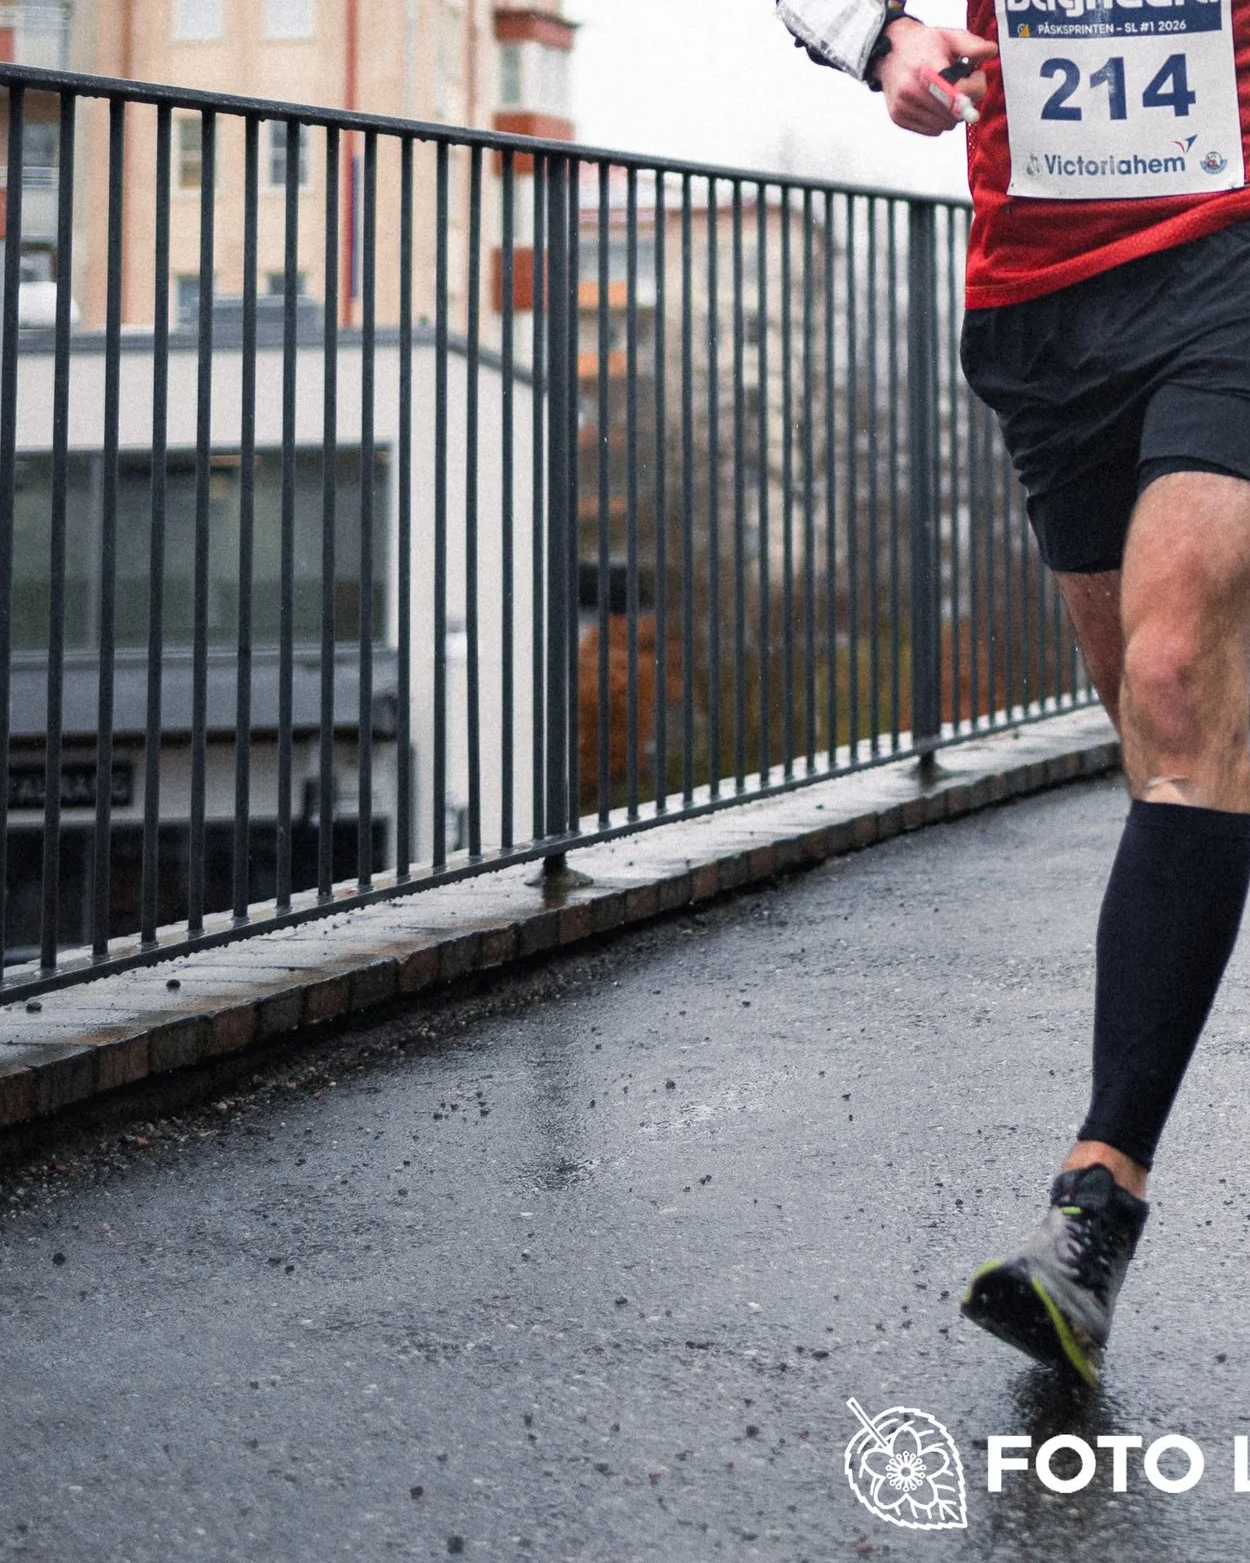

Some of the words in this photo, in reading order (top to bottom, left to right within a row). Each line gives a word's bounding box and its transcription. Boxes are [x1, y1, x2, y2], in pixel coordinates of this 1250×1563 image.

[1038, 22, 1115, 36] PÅSKSPRINTEN
[1124, 21, 1138, 33] SL
[1140, 21, 1154, 33] #1
[1158, 20, 1187, 32] 2026
[1039, 53, 1197, 121] 214
[1044, 152, 1186, 177] Victoriahem
